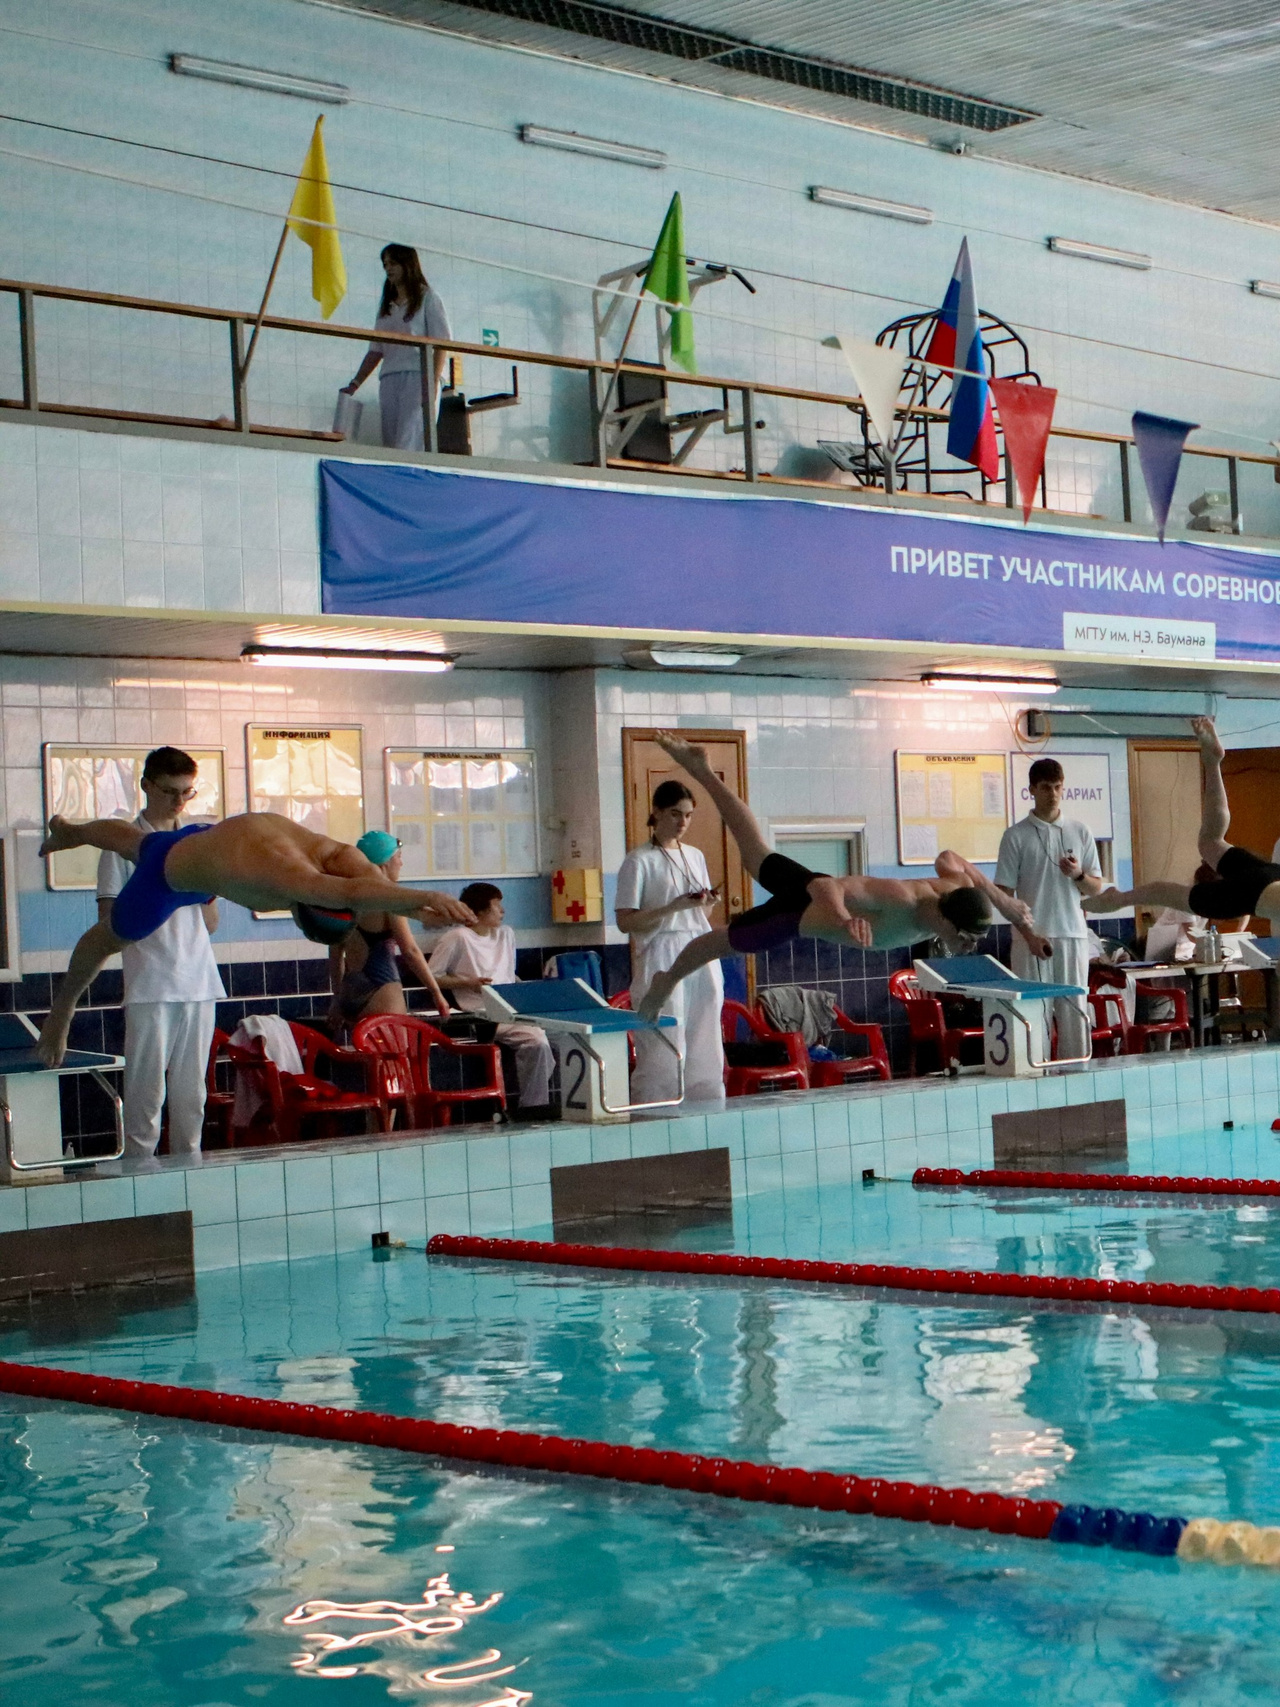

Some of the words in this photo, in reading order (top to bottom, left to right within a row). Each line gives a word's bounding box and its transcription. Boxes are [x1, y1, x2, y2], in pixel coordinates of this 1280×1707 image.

[890, 545, 993, 580] ПРИВЕТ
[1000, 555, 1166, 595] УЧАСТНИКАМ
[1074, 626, 1107, 641] МГТУ
[1110, 631, 1130, 643] им.
[1133, 630, 1154, 644] Н.Э.
[1157, 631, 1206, 649] Баумана
[264, 730, 331, 740] ИНФОРМАЦИЯ
[1021, 787, 1103, 801] СТАРИАТ
[988, 1013, 1010, 1067] 3
[566, 1049, 587, 1110] 2
